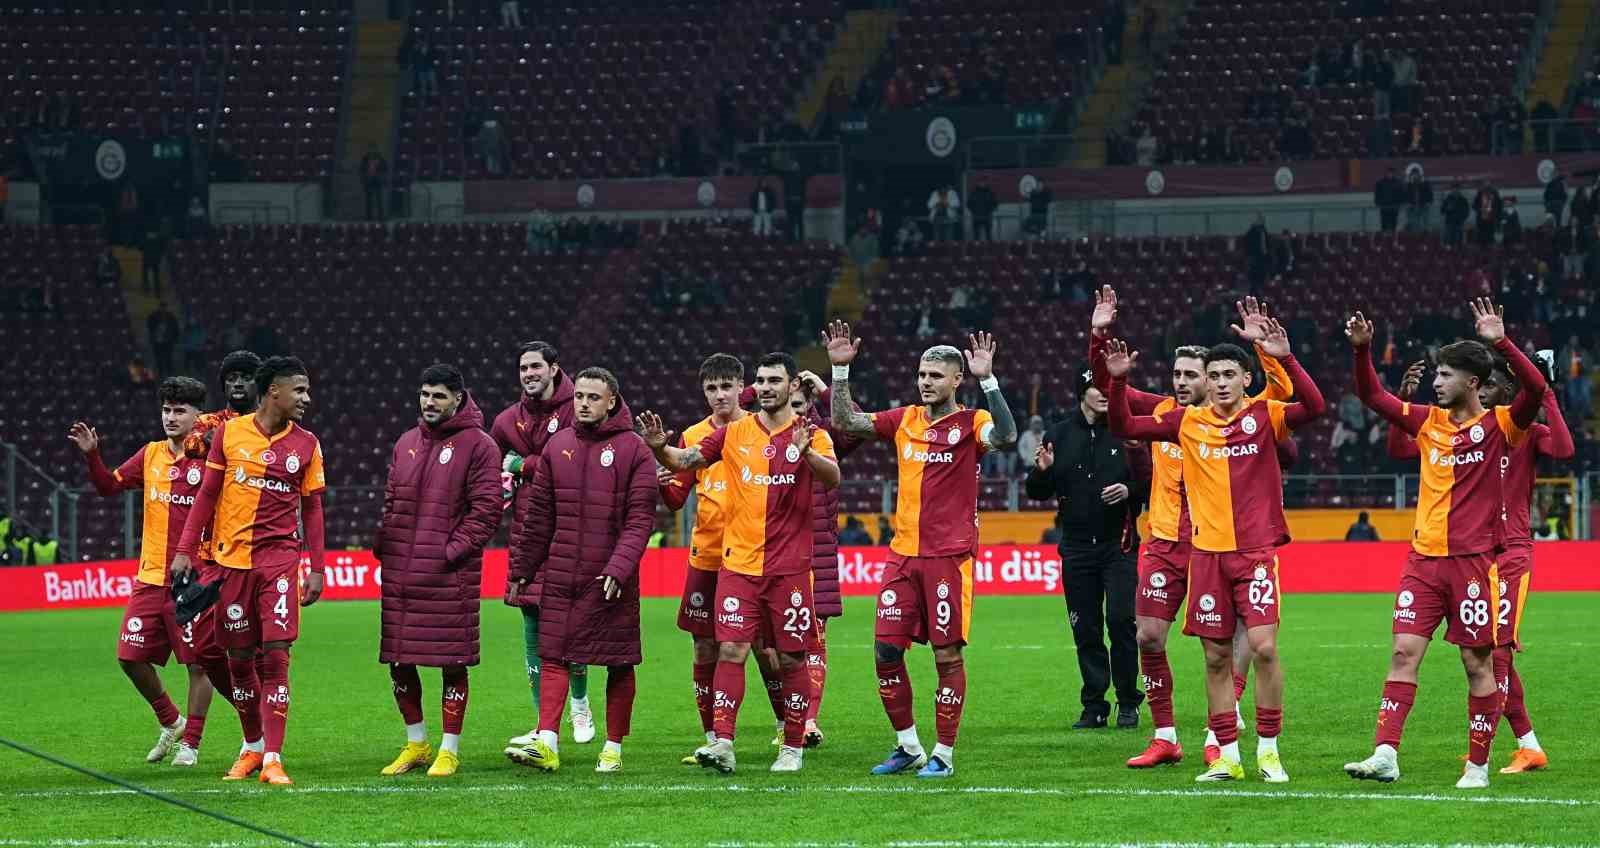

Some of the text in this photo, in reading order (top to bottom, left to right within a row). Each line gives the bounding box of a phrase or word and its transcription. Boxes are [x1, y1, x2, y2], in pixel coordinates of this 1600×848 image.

[913, 451, 953, 463] SOCAR
[1212, 443, 1258, 458] SOCAR
[1439, 451, 1484, 467] SOCAR
[247, 477, 291, 492] SOCAR
[753, 473, 796, 485] SOCAR
[158, 493, 195, 505] SOCAR
[44, 568, 137, 602] Bankka
[1249, 580, 1275, 604] 62
[1142, 587, 1168, 600] Lydia
[273, 595, 289, 618] 4
[685, 606, 709, 618] Lydia
[936, 601, 951, 625] 9
[1460, 599, 1489, 625] 68
[718, 612, 744, 624] Lydia
[783, 607, 811, 630] 23
[1195, 611, 1222, 624] Lydia
